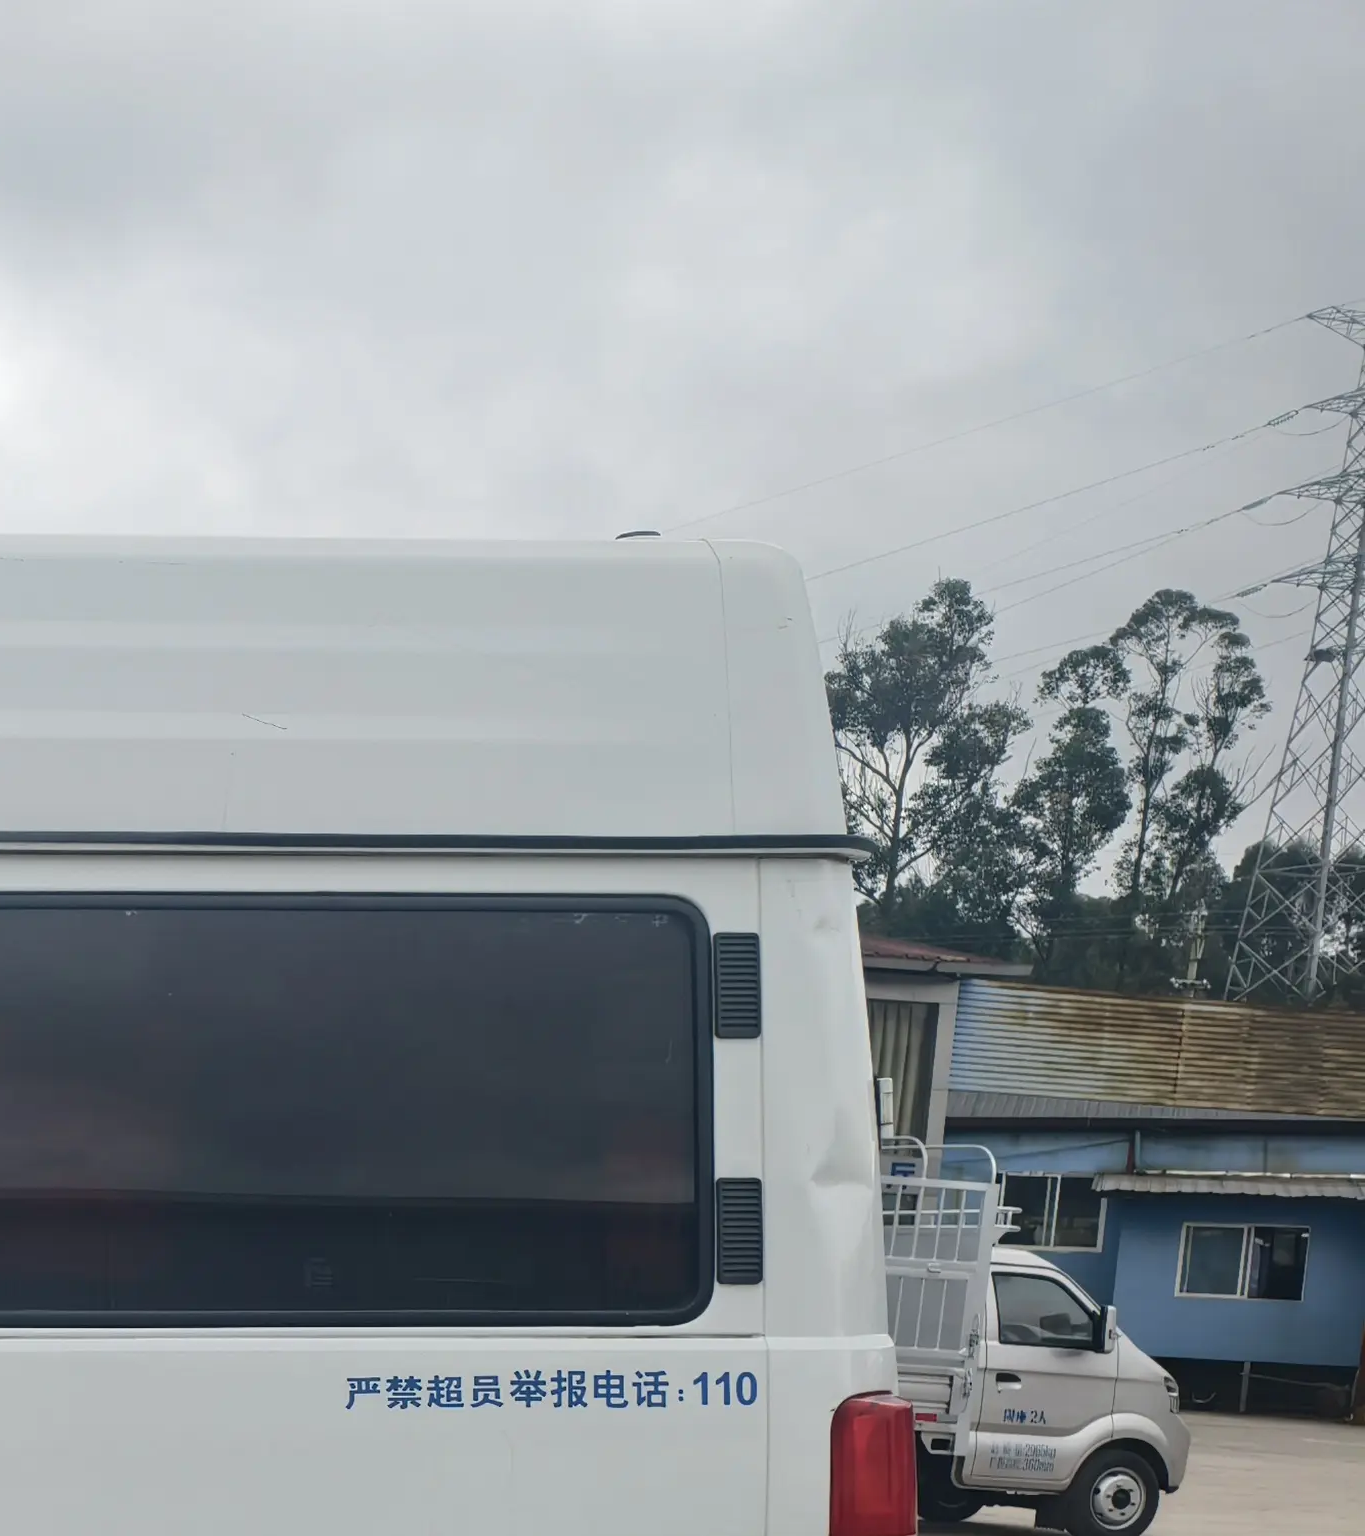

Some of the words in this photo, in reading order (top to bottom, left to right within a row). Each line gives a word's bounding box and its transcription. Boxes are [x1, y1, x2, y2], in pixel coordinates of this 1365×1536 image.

[345, 1369, 759, 1410] 严禁超员举报电话:110
